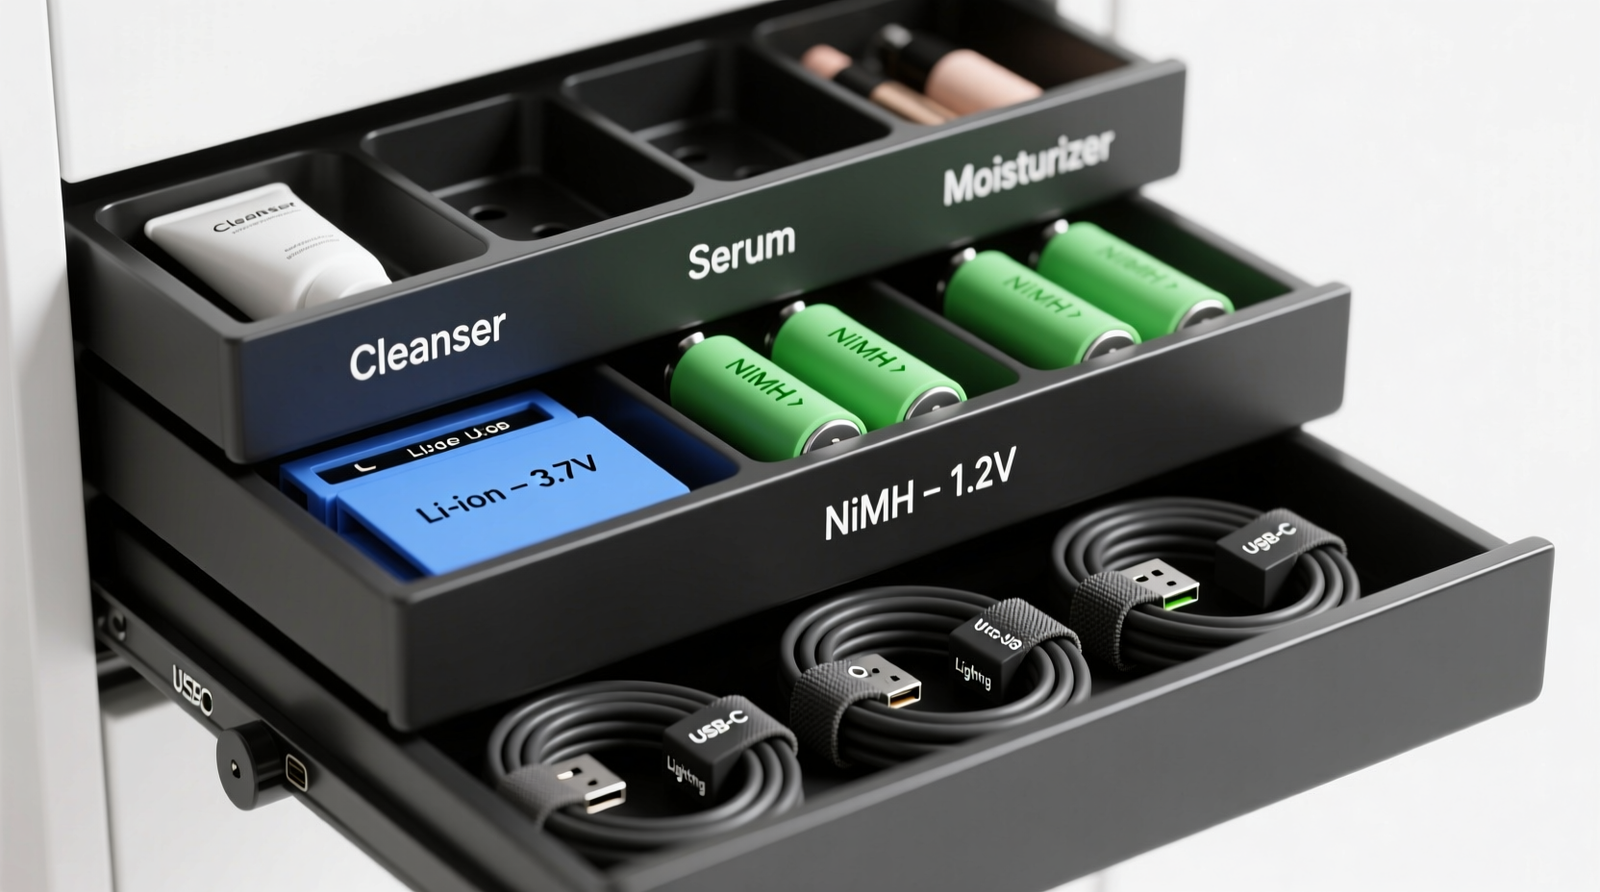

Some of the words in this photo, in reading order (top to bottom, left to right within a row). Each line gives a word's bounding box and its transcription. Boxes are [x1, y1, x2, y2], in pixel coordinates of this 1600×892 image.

[943, 130, 1115, 206] Moisturizer
[212, 202, 296, 233] Cleanser
[688, 226, 796, 280] Serum
[350, 312, 507, 381] Cleanser
[415, 488, 507, 524] Li-ion
[530, 454, 597, 487] 3.7V
[825, 479, 914, 541] NiMH
[950, 445, 1017, 497] 1.2V
[688, 710, 749, 744] USB-C
